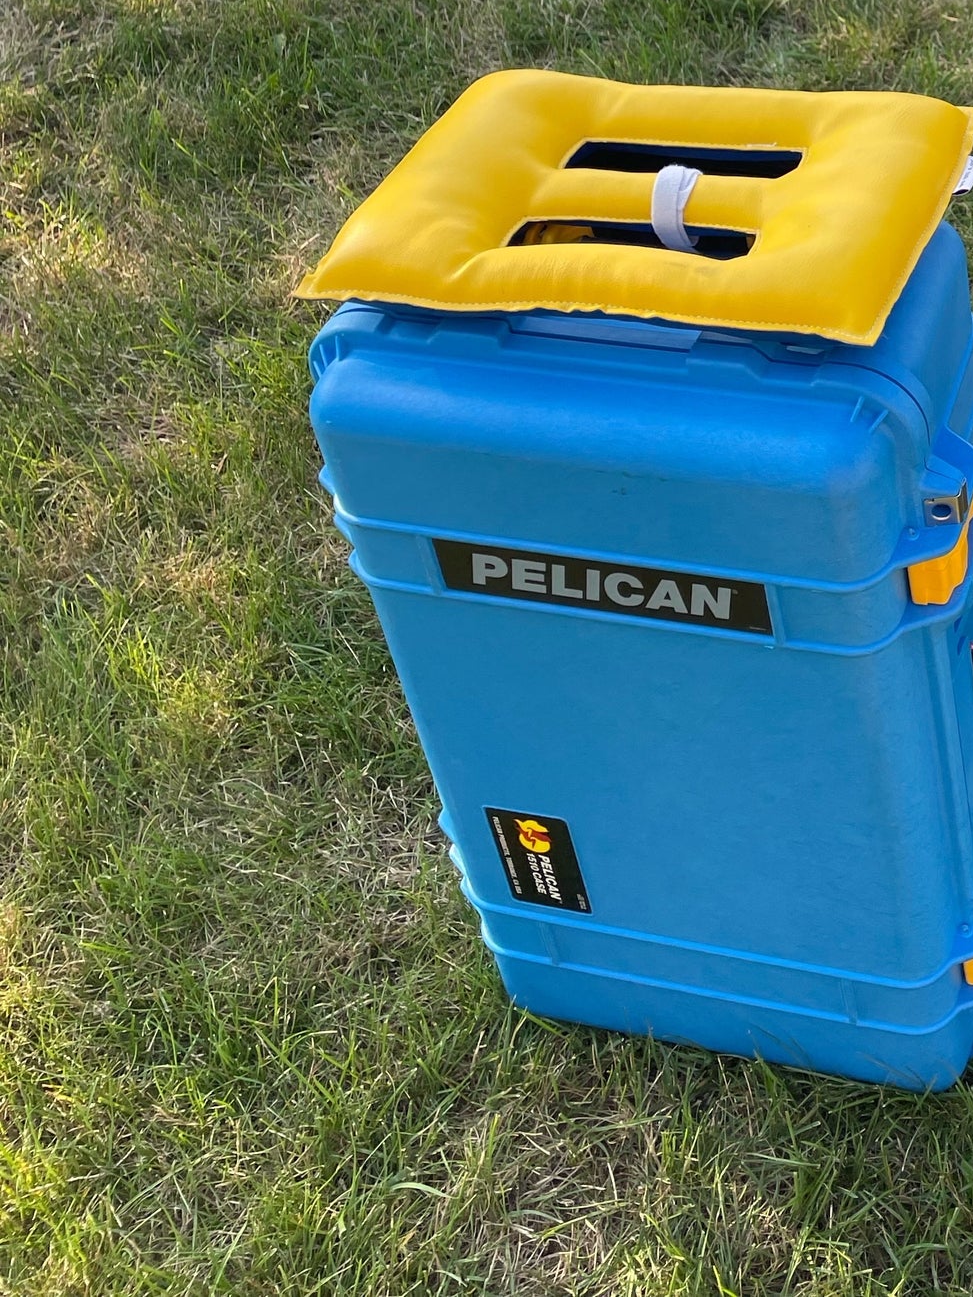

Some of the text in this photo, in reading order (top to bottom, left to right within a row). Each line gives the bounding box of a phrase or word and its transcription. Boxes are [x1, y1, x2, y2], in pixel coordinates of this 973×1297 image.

[471, 552, 733, 621] PELICAN
[526, 852, 548, 896] 1510 CASE
[538, 854, 563, 902] PELICAN
